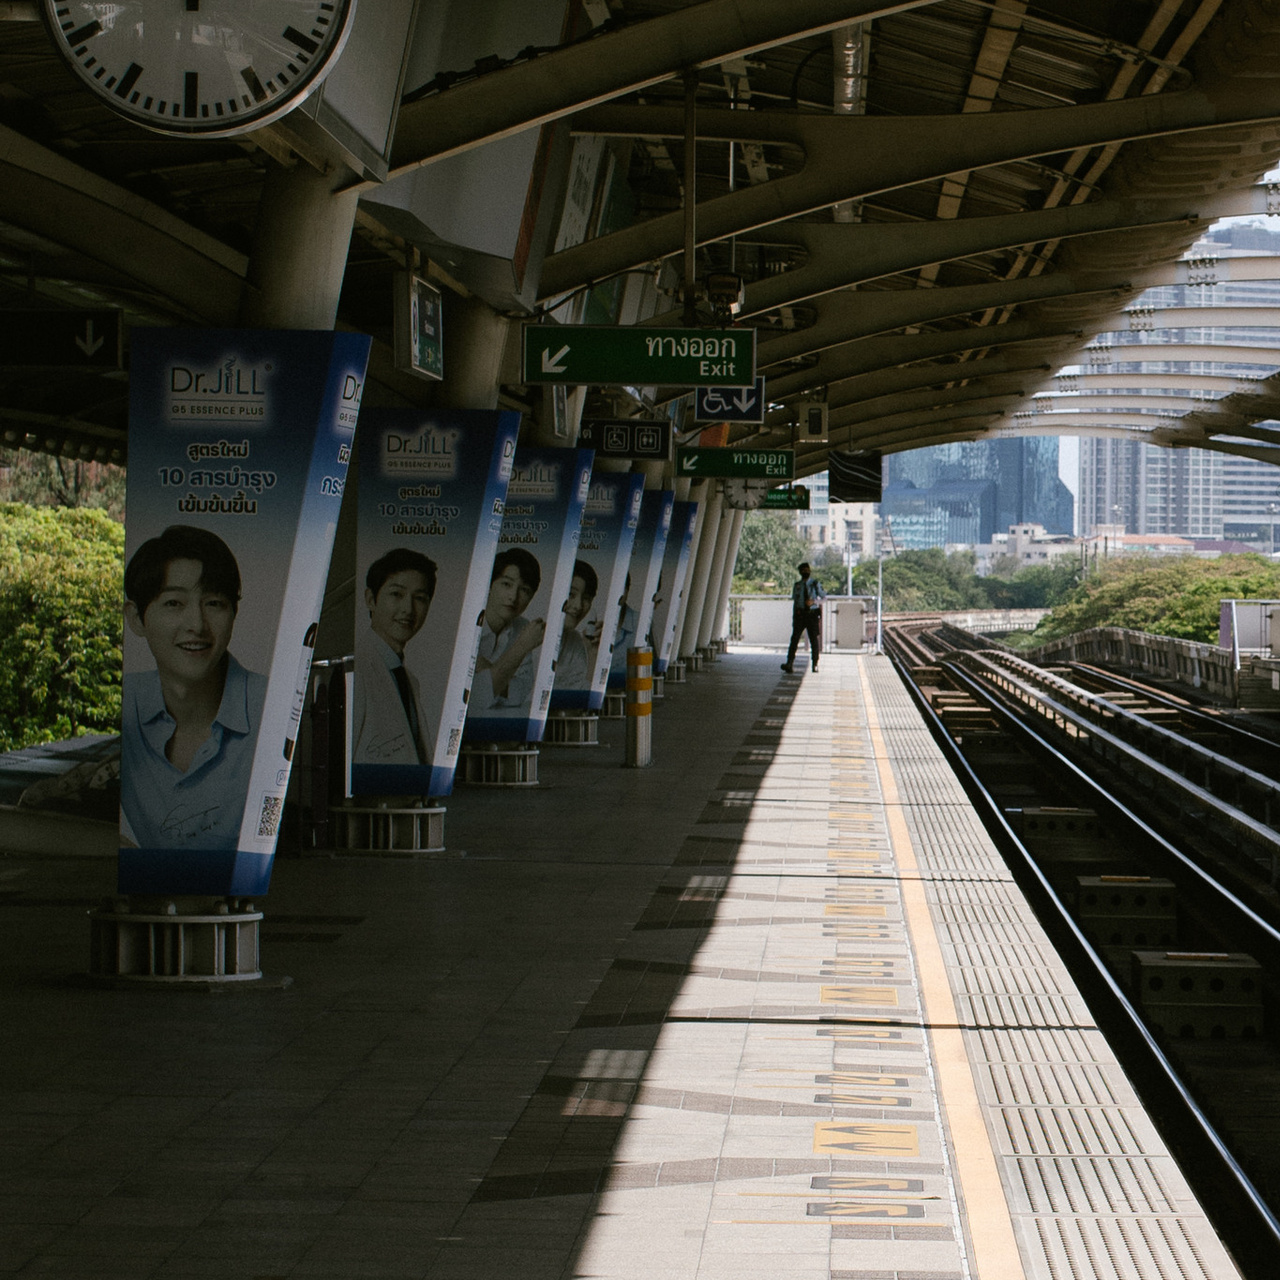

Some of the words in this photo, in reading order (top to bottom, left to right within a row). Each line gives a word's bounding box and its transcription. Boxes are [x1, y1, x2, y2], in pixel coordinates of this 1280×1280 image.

[645, 336, 737, 358] ทางออก
[700, 360, 736, 377] Exit
[171, 406, 187, 415] G5
[190, 405, 236, 416] ESSENCE
[238, 406, 265, 417] PLUS
[188, 440, 250, 462] สูตรใหม่
[732, 451, 787, 465] ทางออก
[160, 468, 184, 487] 10
[190, 465, 276, 493] สารบำรุง
[766, 465, 787, 476] Exit
[399, 485, 441, 500] สูตรใหม่
[177, 491, 257, 514] เข้มข้นขึ้น
[379, 504, 396, 516] 10
[400, 502, 459, 520] สารบำรุง
[392, 520, 447, 536] เข้มข้นขึ้น
